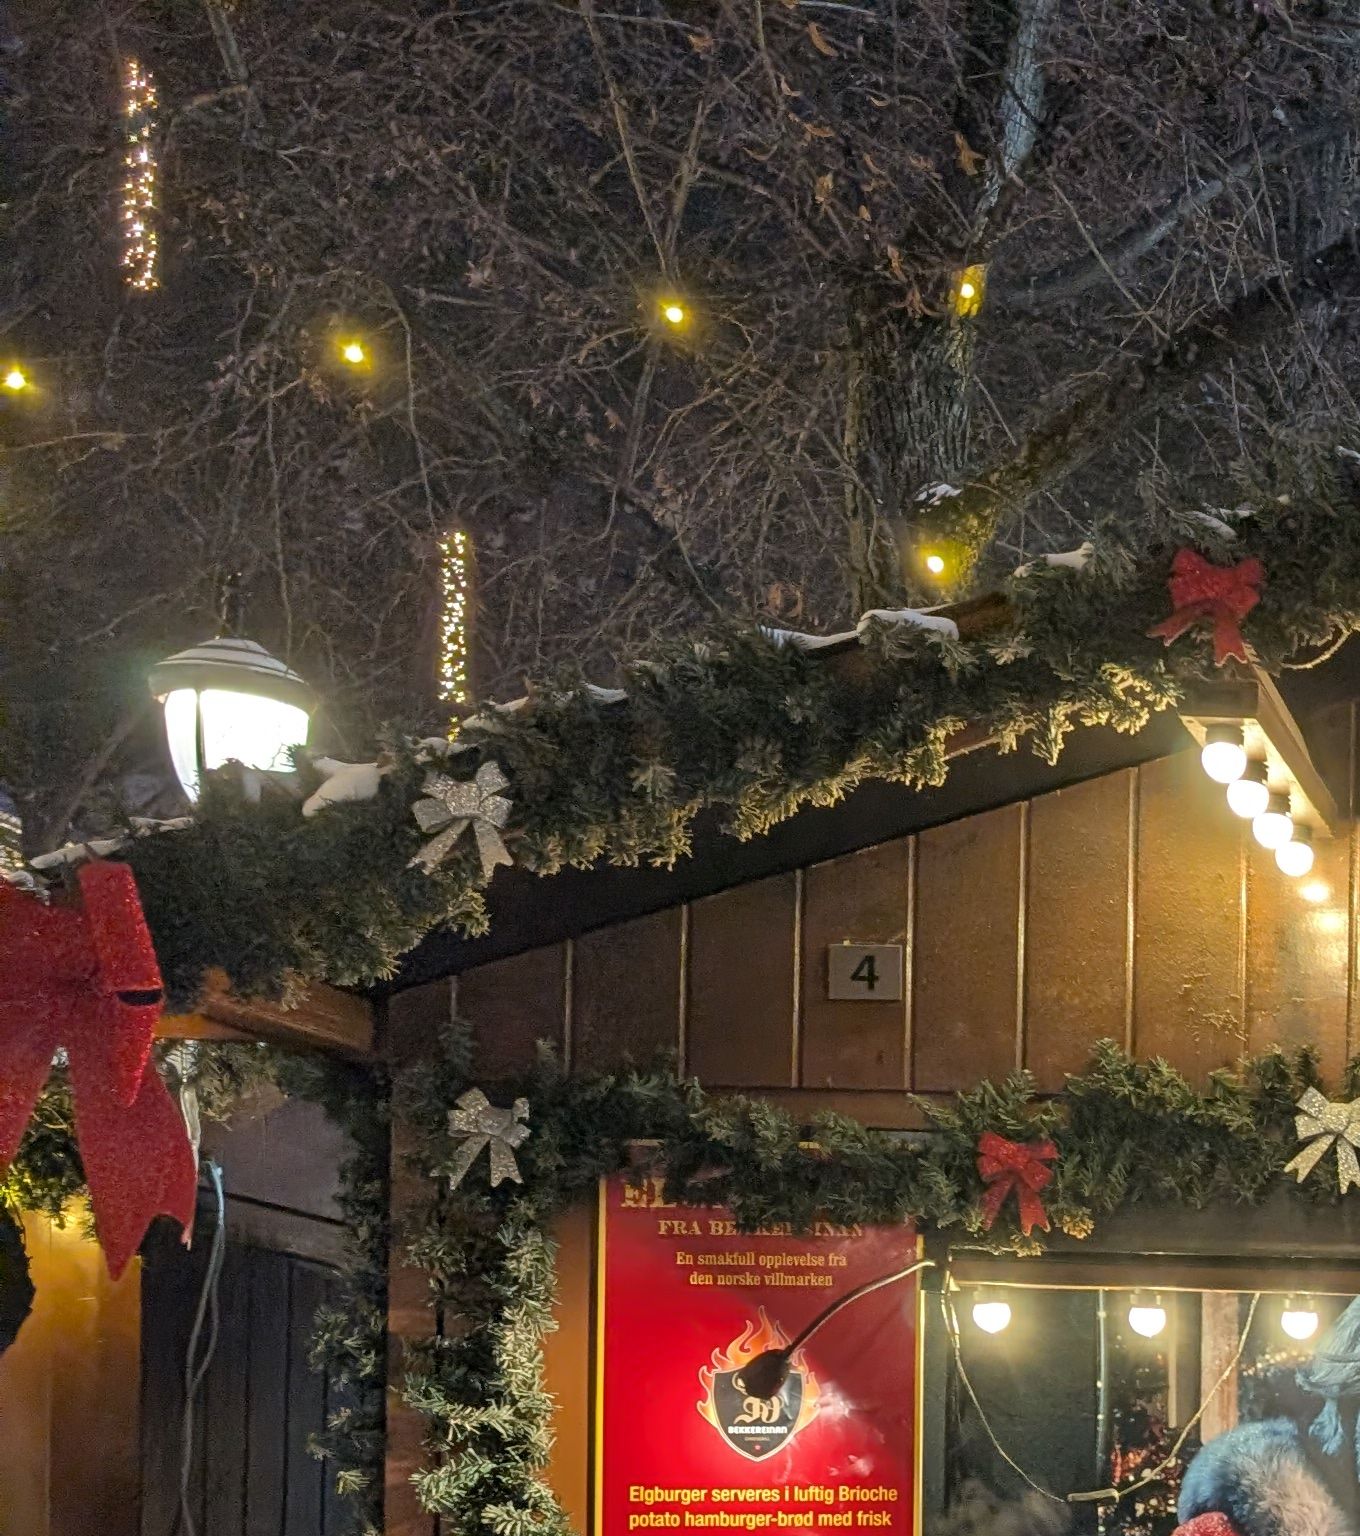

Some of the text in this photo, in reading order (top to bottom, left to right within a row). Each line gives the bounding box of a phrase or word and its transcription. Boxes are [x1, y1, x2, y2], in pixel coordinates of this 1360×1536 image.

[850, 954, 879, 991] 4
[658, 1220, 701, 1235] FRA
[676, 1252, 847, 1267] En smakfull opplevelse fra
[690, 1272, 832, 1287] den norske villmarken
[629, 1485, 897, 1503] Elgburger serveres i luftig Brioche
[629, 1509, 892, 1529] potato hamburger-brød med frisk
